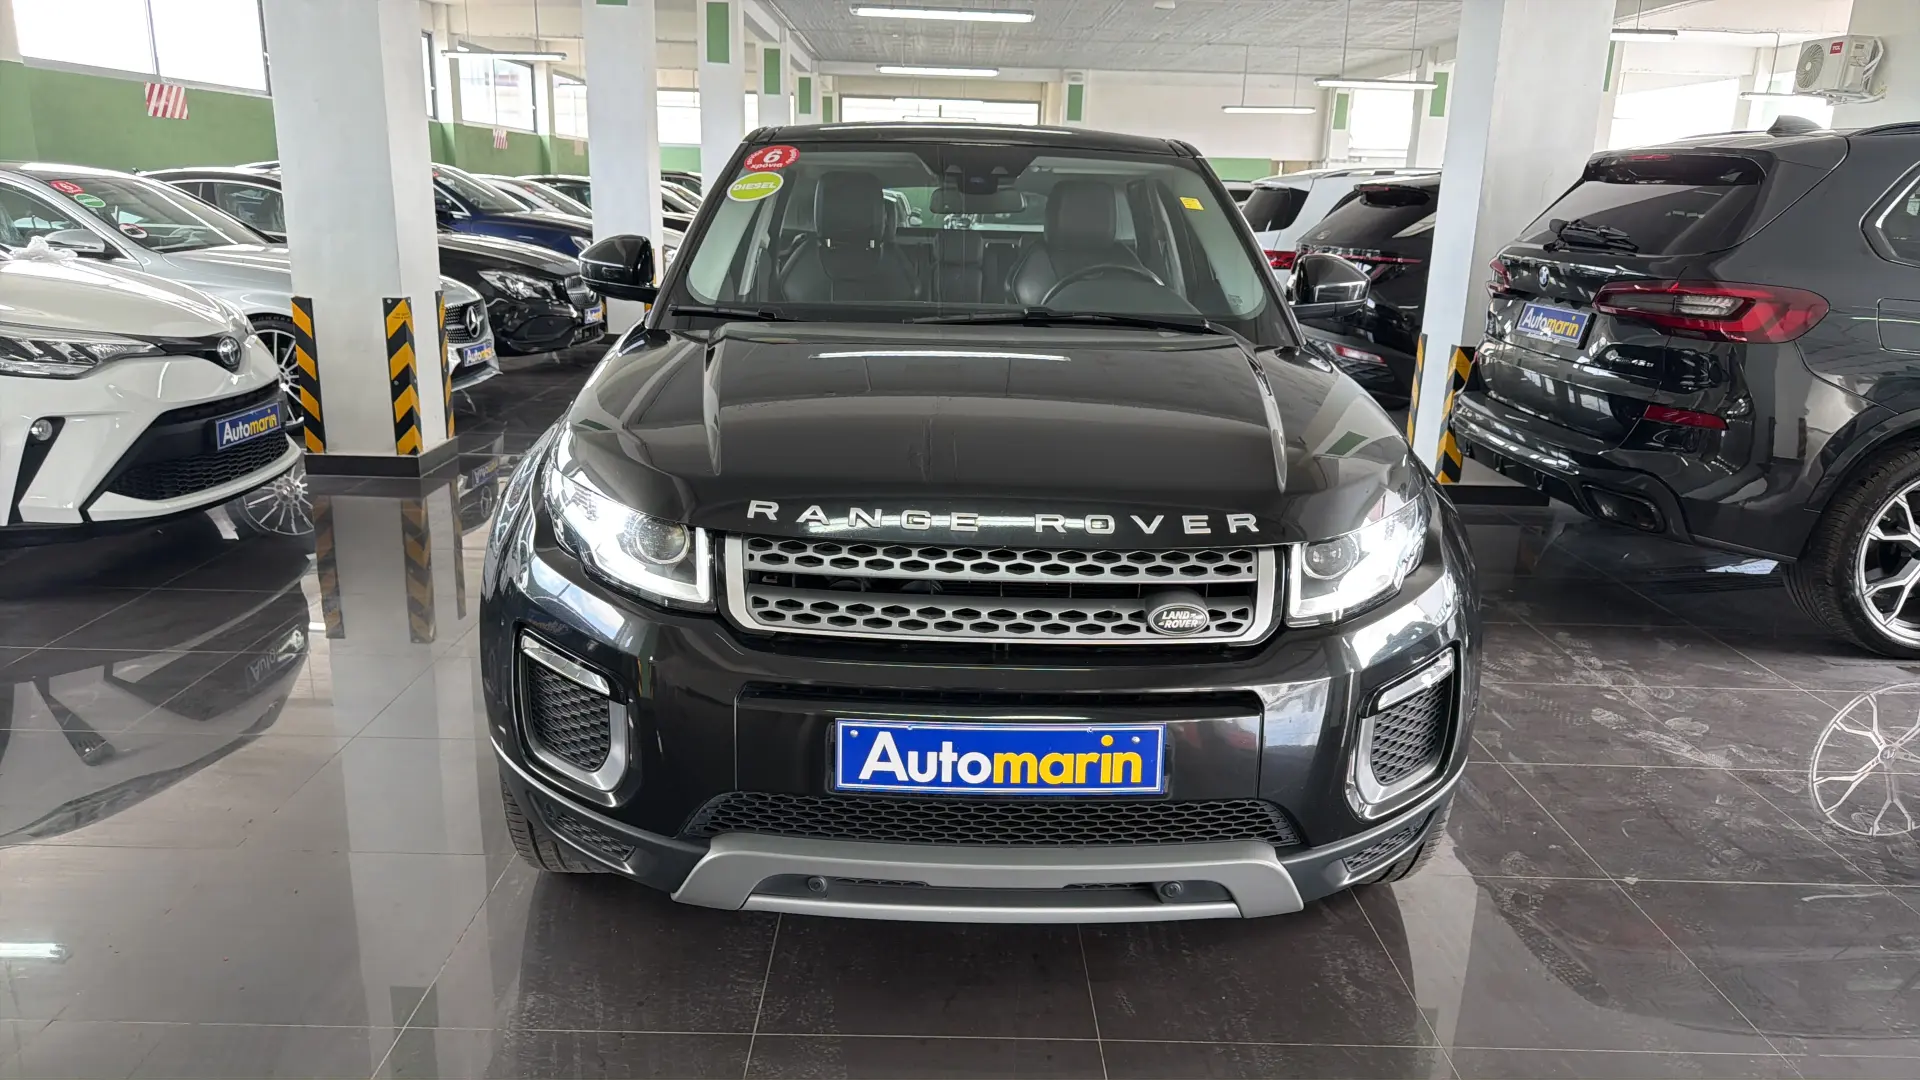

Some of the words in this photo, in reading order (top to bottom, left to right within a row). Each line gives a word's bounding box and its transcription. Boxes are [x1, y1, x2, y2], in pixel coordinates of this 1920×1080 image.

[763, 151, 782, 163] 6
[733, 182, 776, 190] DIESEL
[1522, 308, 1579, 337] Automarin
[222, 408, 278, 445] Automarin
[747, 500, 979, 532] RANGE
[1035, 513, 1260, 534] ROVER
[1162, 611, 1190, 619] LAND
[1164, 620, 1198, 628] ROVER
[858, 731, 1142, 785] Automarin
